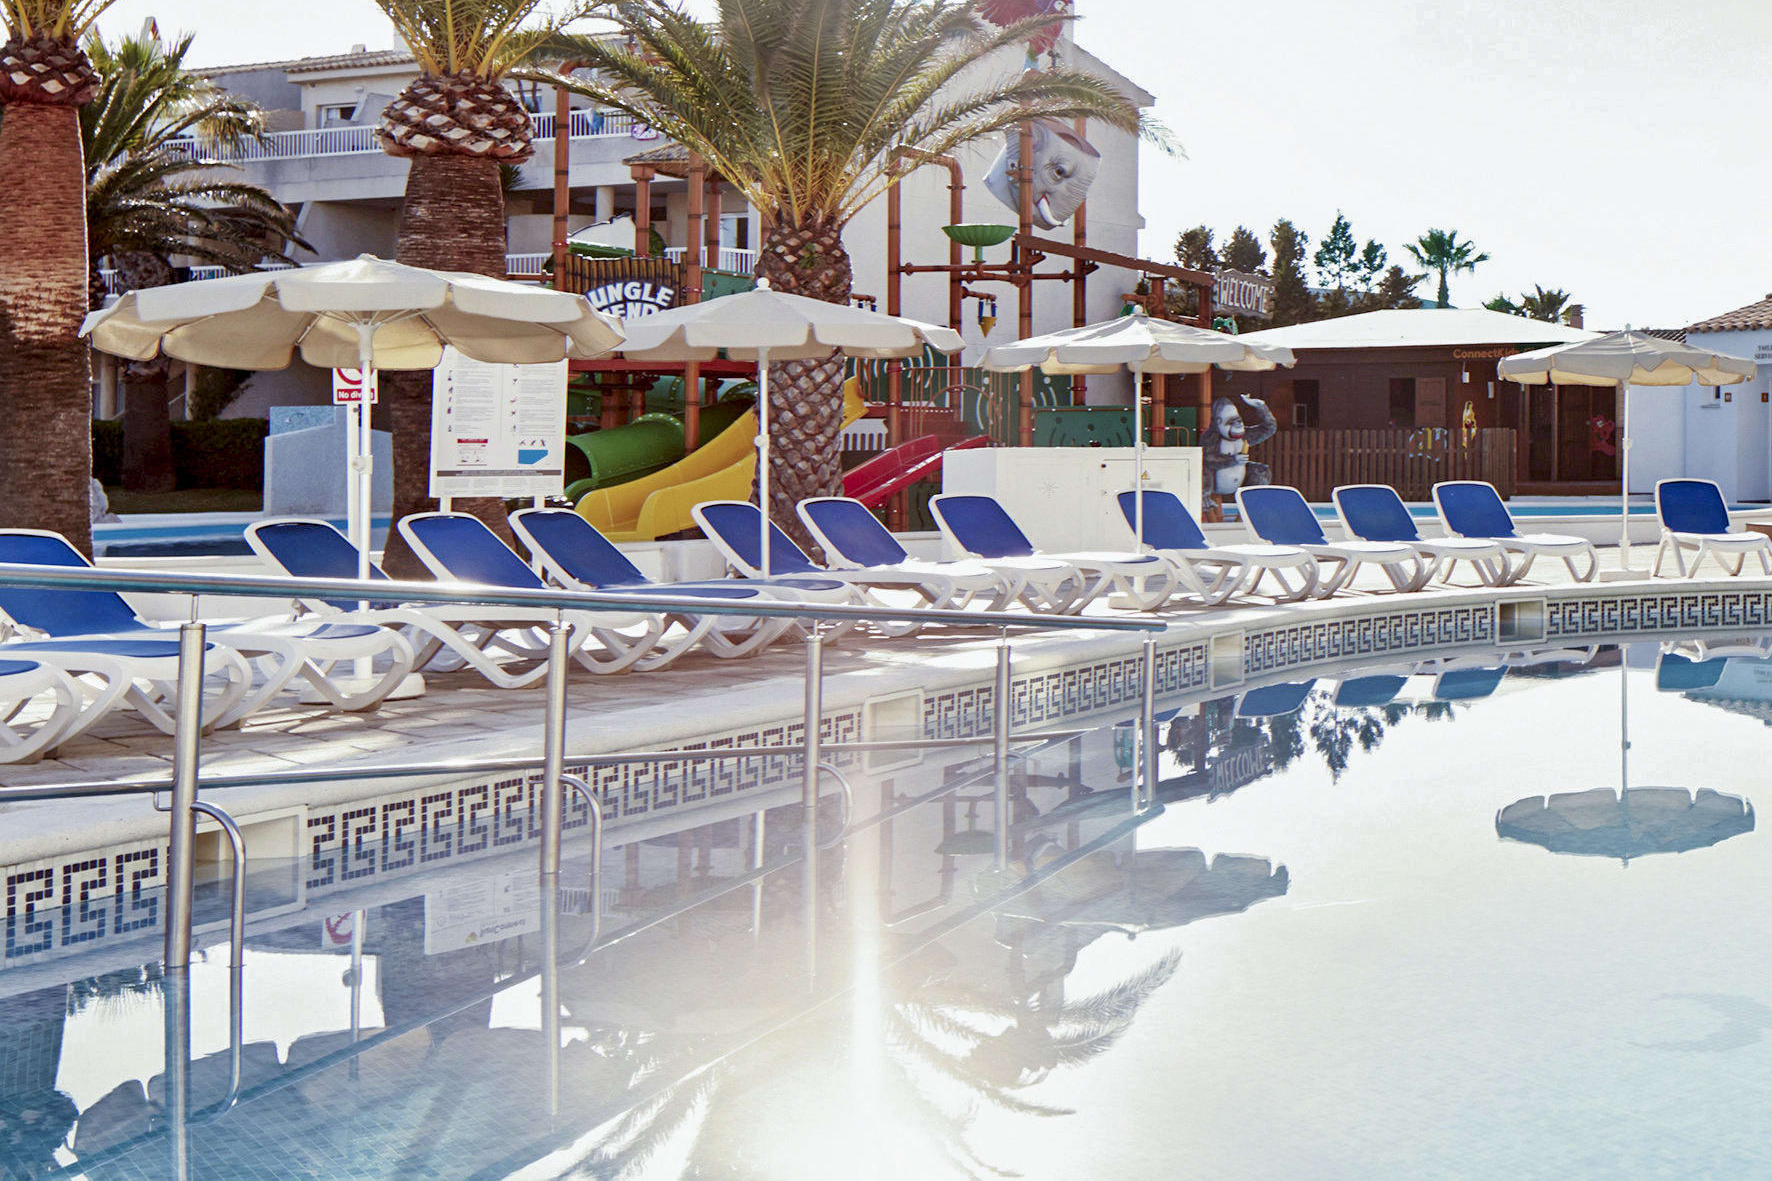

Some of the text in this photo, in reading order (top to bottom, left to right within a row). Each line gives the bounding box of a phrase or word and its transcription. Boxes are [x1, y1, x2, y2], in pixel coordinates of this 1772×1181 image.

[586, 282, 675, 308] UNGLE
[1217, 276, 1268, 313] WELCOME
[338, 391, 349, 399] No
